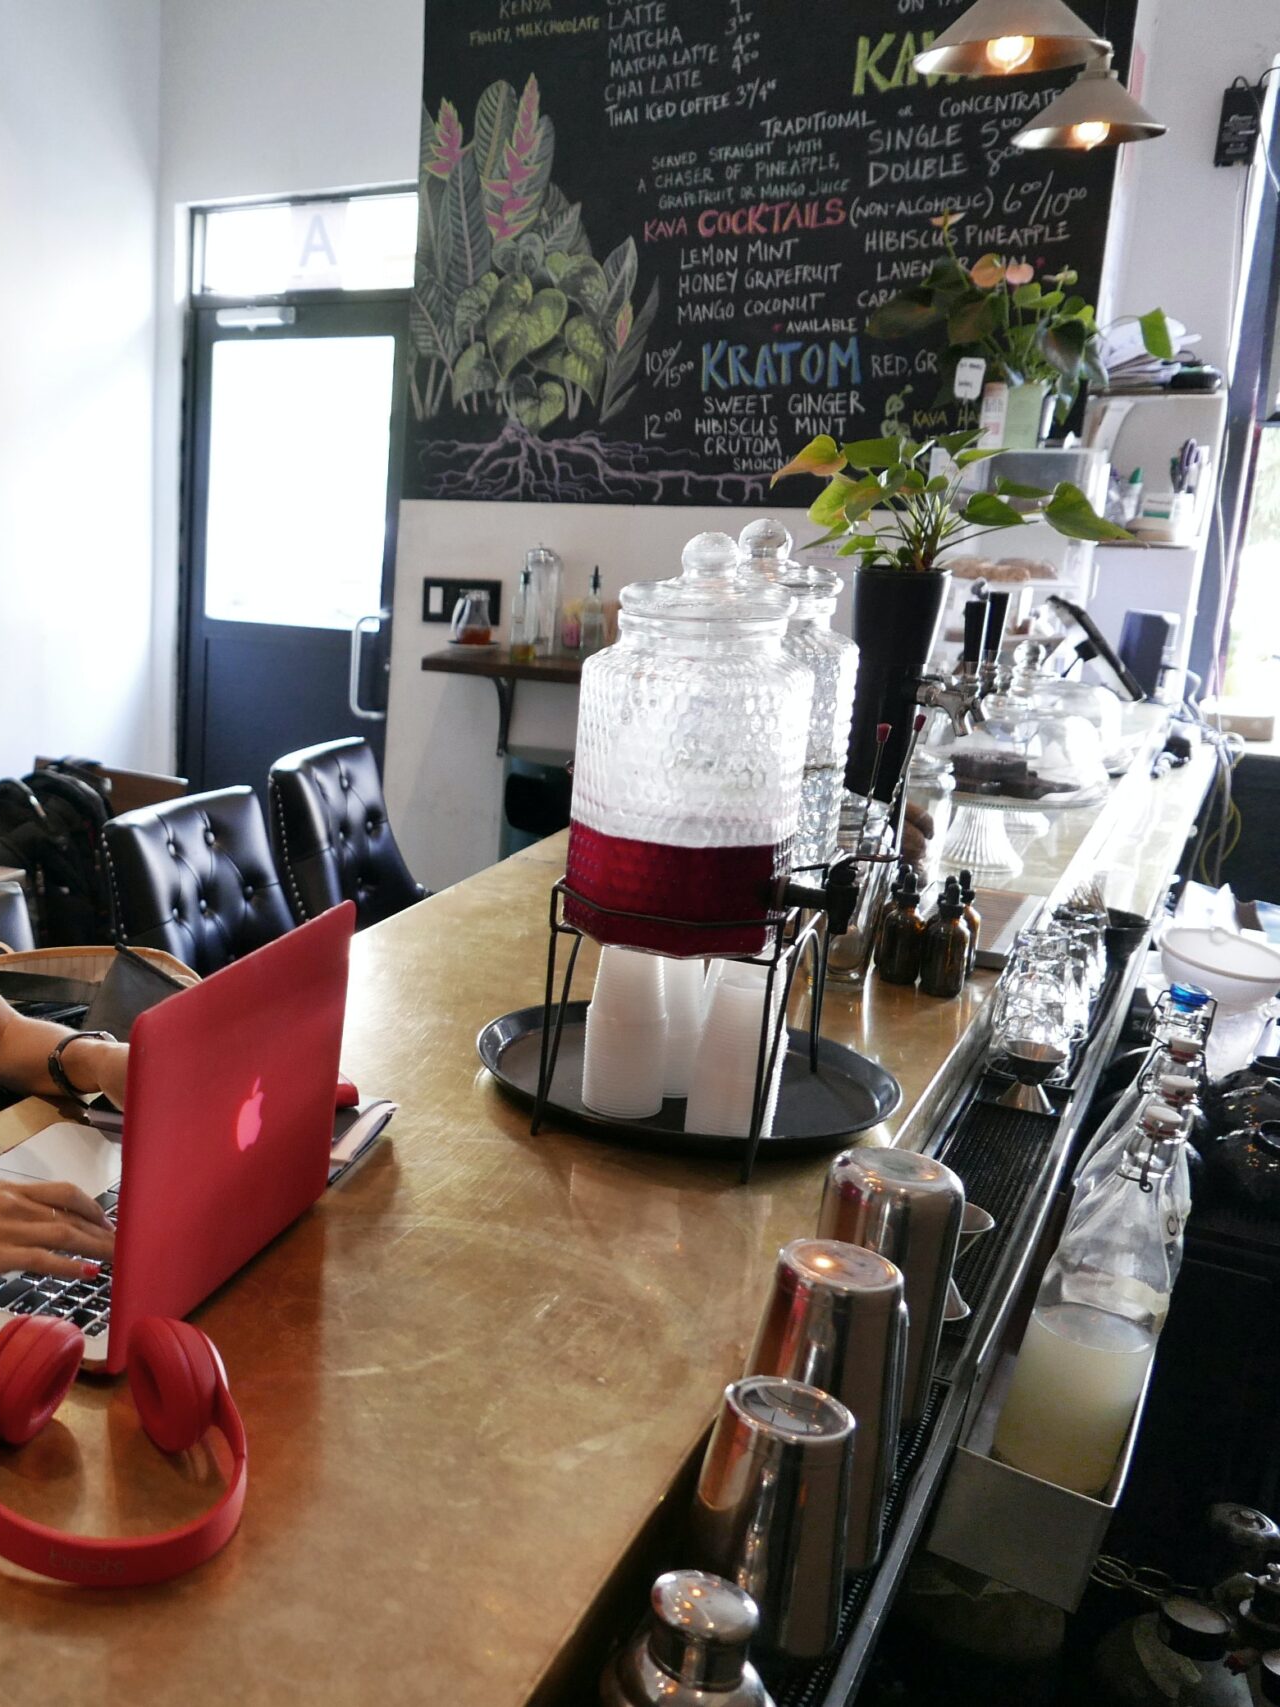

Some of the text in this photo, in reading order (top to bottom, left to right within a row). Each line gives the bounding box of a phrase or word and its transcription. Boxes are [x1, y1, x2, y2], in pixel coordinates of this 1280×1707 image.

[608, 2, 666, 30] LATTE
[608, 26, 683, 59] MATCHA
[610, 53, 668, 78] MATCHA
[672, 43, 719, 66] LATTE
[604, 79, 643, 102] CHAI
[650, 69, 703, 94] LATTE
[605, 103, 638, 127] THAI
[645, 101, 676, 122] ICED
[680, 92, 731, 117] COFFEE
[760, 111, 877, 138] TRADITIONAL
[652, 138, 822, 170] SERVED STRAIGHT WITH
[868, 123, 963, 155] SINGLE
[637, 178, 646, 193] A
[655, 168, 714, 189] CHASER
[725, 163, 744, 181] OF
[868, 152, 967, 188] DOUBLE
[761, 182, 805, 199] MANGO
[809, 178, 851, 197] JUICE
[644, 216, 688, 243] KAVA
[697, 197, 847, 238] COCKTAILS
[299, 213, 338, 267] A
[680, 237, 800, 270] LEMON MINT
[864, 221, 1071, 254] HIBISCUS PINEAPPLE
[678, 263, 842, 298] HONEY GRAPEFRUIT
[677, 292, 826, 326] MANGO COCONUT
[786, 316, 858, 334] AVAILABLE
[701, 335, 863, 392] KRATOM
[704, 390, 866, 415] SWEET GINGER
[912, 409, 948, 427] KAVA
[695, 415, 778, 436] HIBISCUS
[795, 416, 847, 436] MINT
[703, 436, 782, 457] CRUTOM
